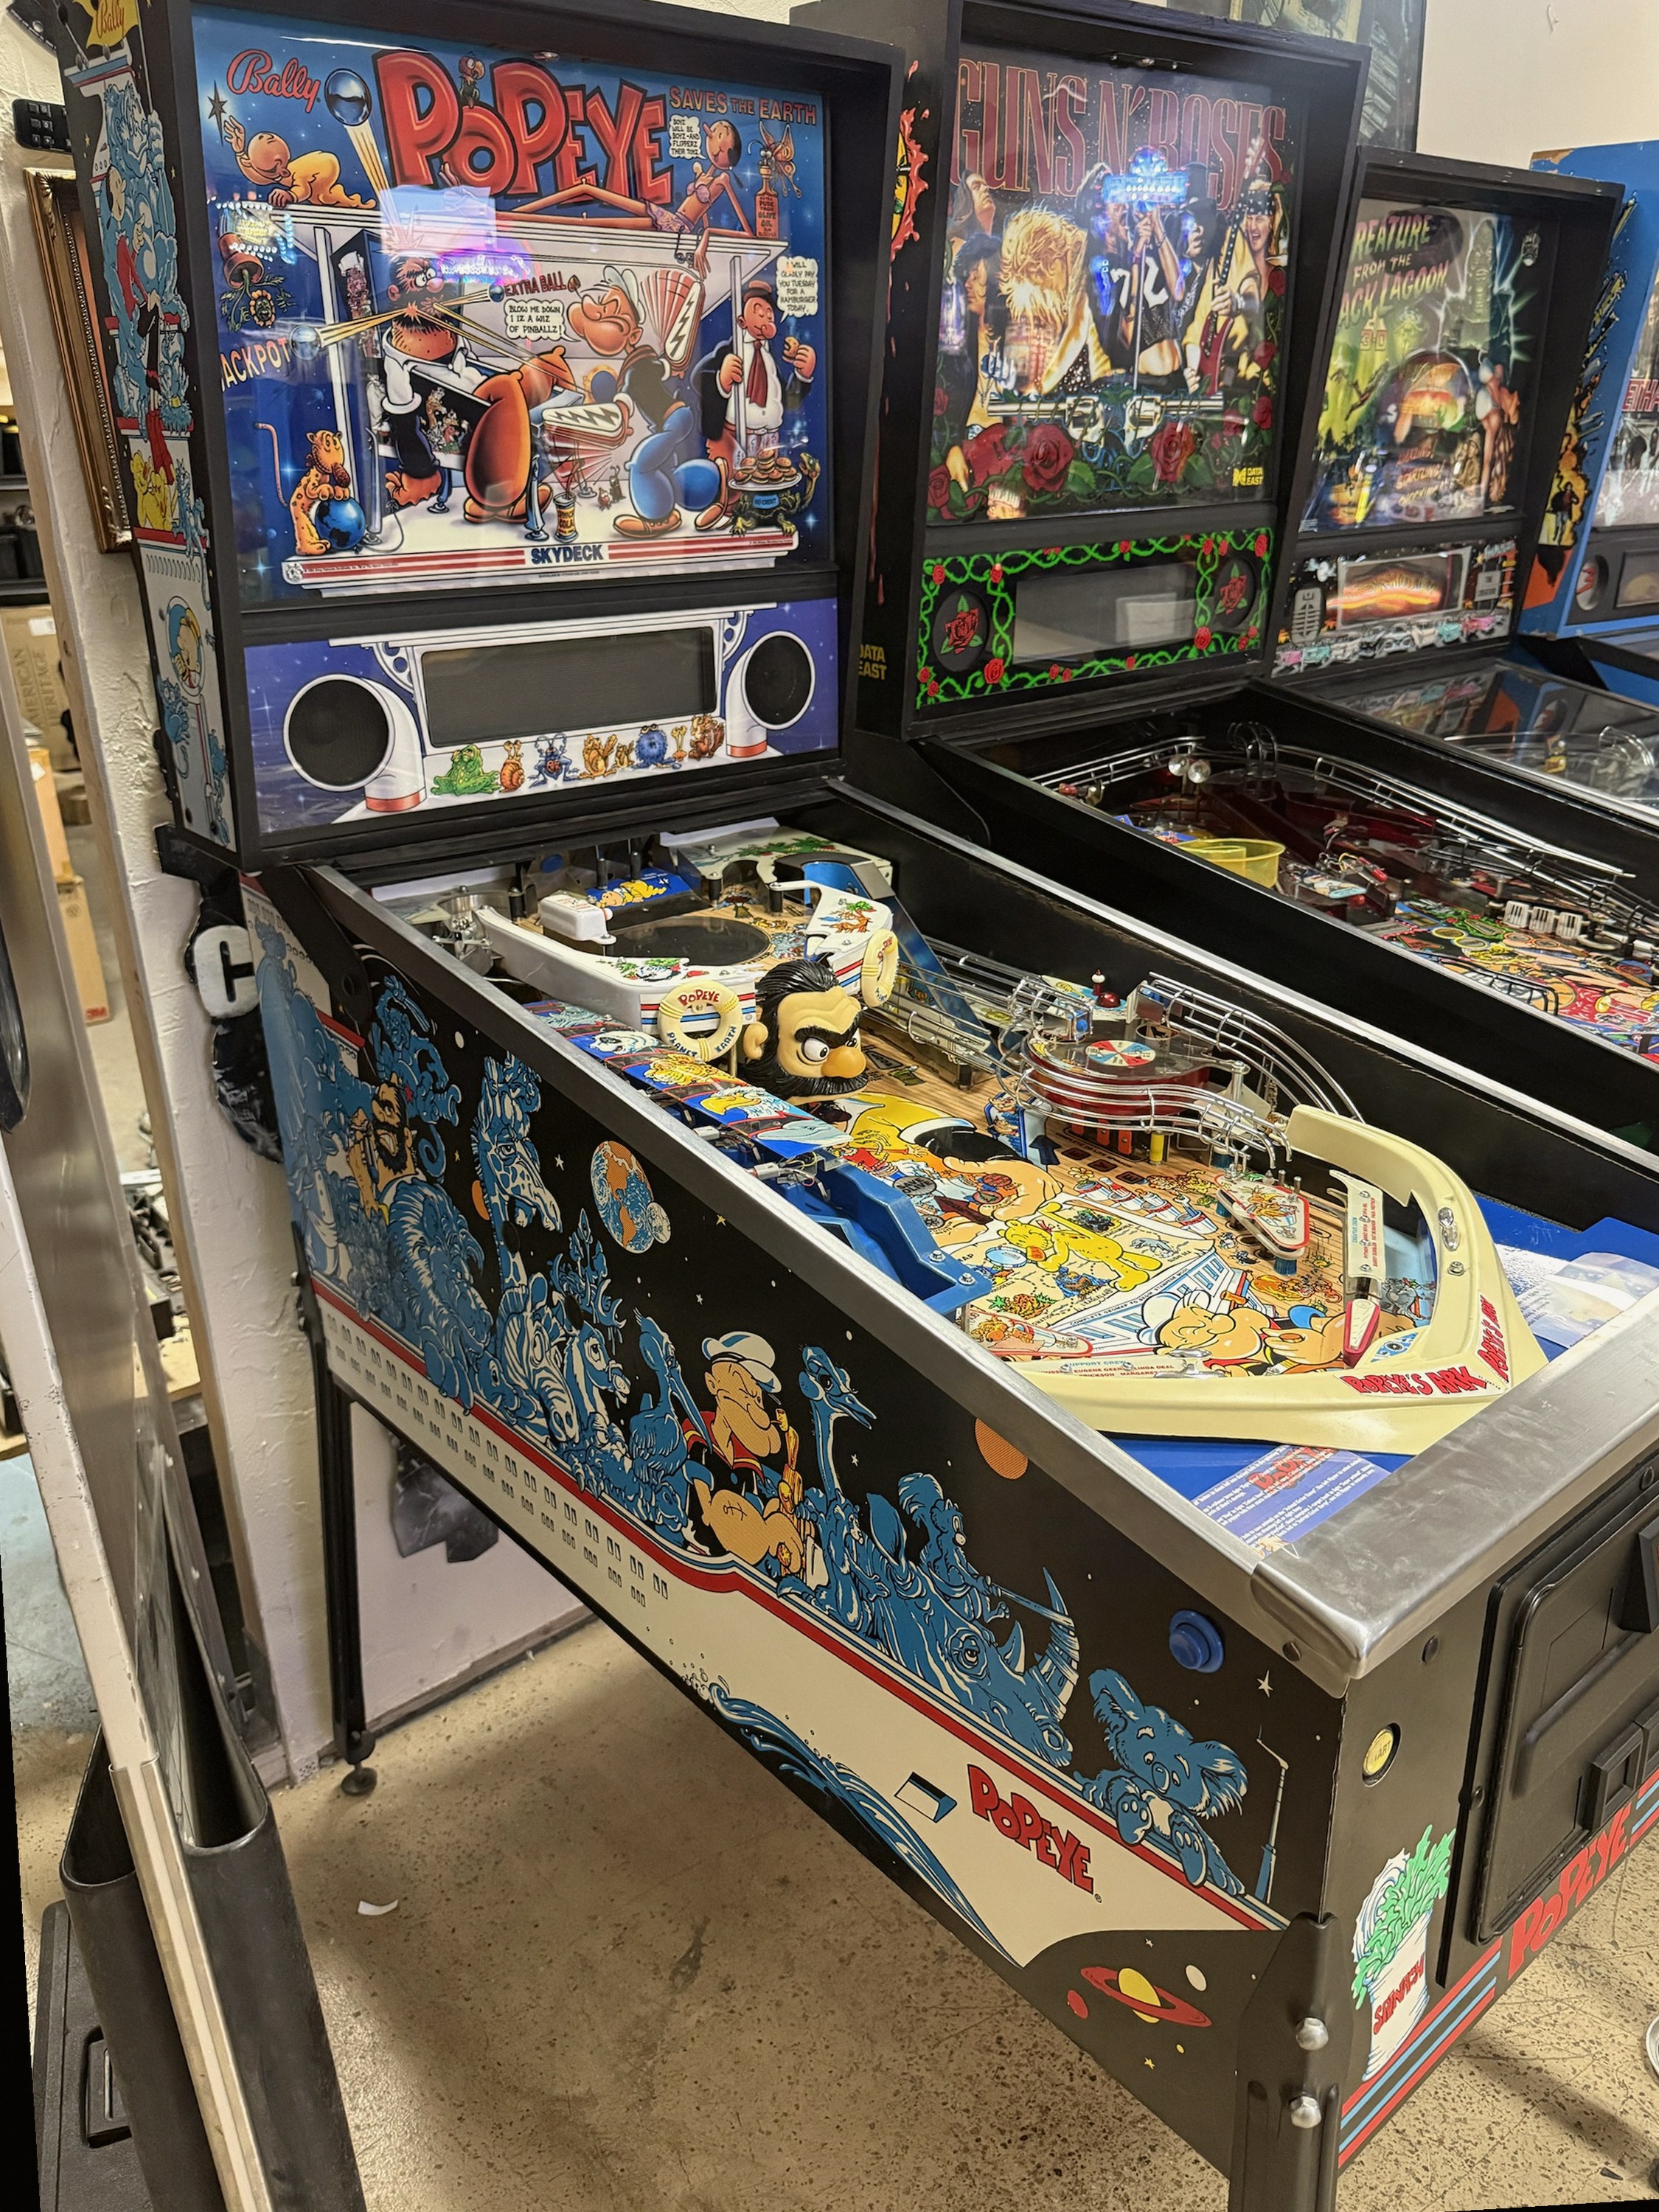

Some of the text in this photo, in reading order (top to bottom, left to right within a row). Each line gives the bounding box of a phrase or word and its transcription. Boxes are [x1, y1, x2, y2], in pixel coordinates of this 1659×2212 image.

[226, 49, 321, 114] Bally
[669, 86, 817, 125] SAVES THE EARTH
[372, 47, 675, 206] POPEYE
[672, 139, 698, 147] FLIPPERZ
[950, 58, 1088, 197] GUNS
[1147, 87, 1287, 211] ROSES
[1352, 214, 1433, 263] REATURE
[504, 271, 567, 297] EXTRA BALL
[778, 279, 815, 288] YOU TUESDAY
[1352, 253, 1413, 288] FROM THE
[779, 296, 816, 304] HAMBURGER
[1377, 260, 1449, 319] LAGOON
[509, 305, 529, 313] BLOW
[1246, 476, 1264, 485] EAST
[530, 544, 604, 565] SKYDECK
[678, 989, 720, 1007] POPEYE
[667, 1026, 737, 1057] PLANET EARTH
[897, 1178, 923, 1189] SAVE
[902, 1180, 932, 1194] OLIVE
[1070, 1312, 1102, 1326] COMPLETE
[1130, 1299, 1138, 1307] TO
[1139, 1291, 1153, 1302] BEGIN
[1154, 1278, 1176, 1292] STAMPEDE
[1480, 1294, 1501, 1329] ARK
[1477, 1319, 1510, 1383] POPEYE'S
[1339, 1373, 1433, 1396] POPEYE'S
[1425, 1366, 1488, 1395] ARK
[967, 1764, 1094, 1895] POPEYE
[1508, 1801, 1632, 1981] POPEYE
[1374, 1953, 1425, 2035] SPINACH
